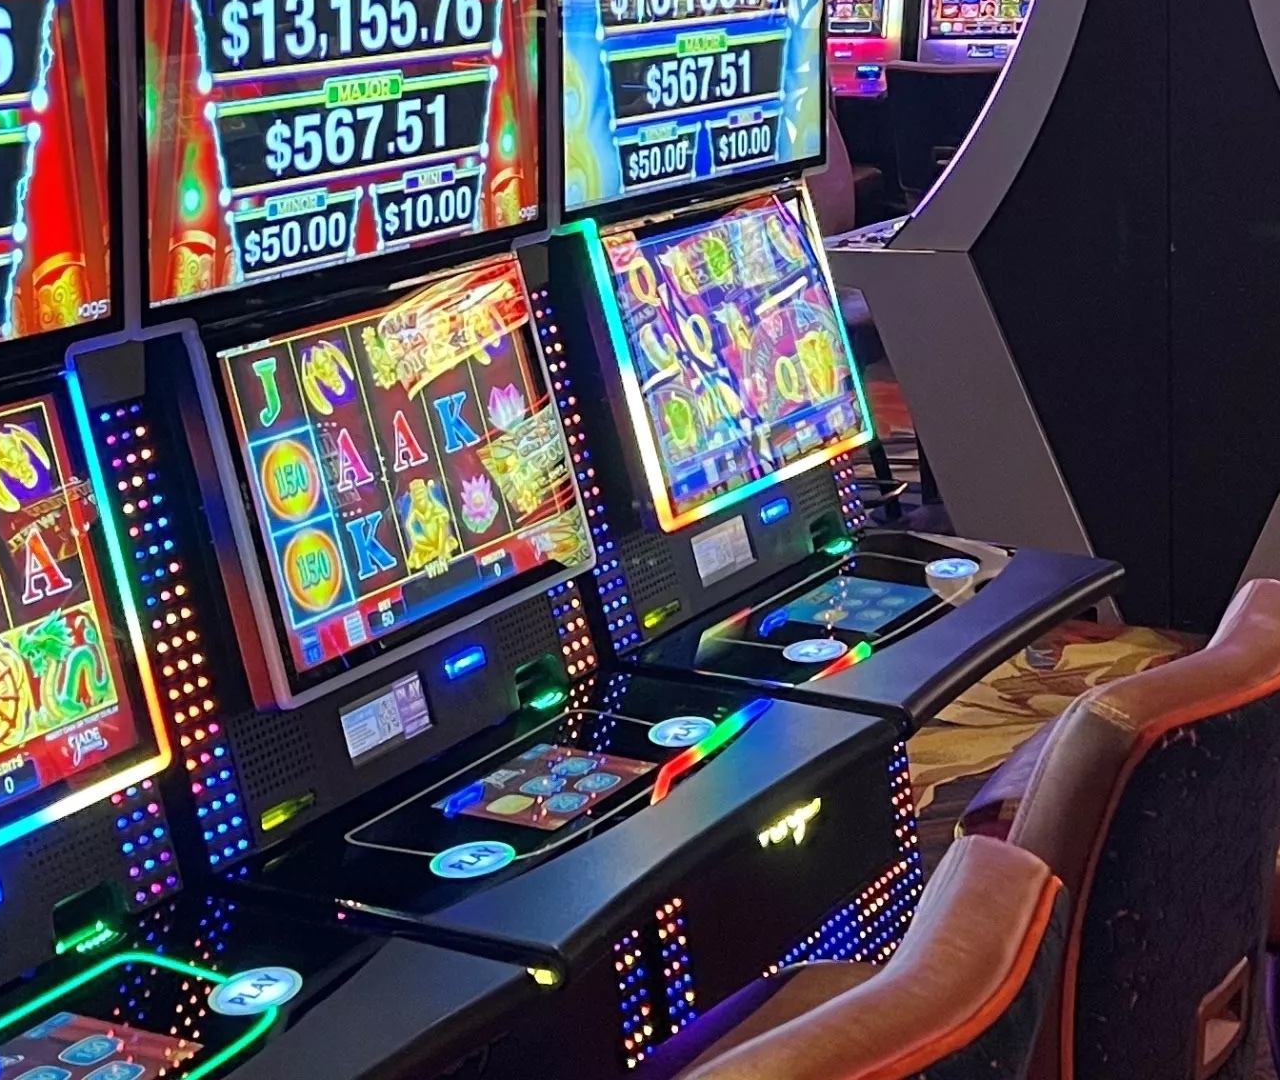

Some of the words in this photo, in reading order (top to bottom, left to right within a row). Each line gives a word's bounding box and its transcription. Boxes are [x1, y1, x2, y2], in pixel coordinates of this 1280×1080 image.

[336, 78, 395, 102] MAJOR
[646, 49, 751, 110] $567.51
[265, 94, 447, 178] $567.51
[719, 125, 771, 162] $10.00
[629, 140, 687, 180] $50.00
[384, 186, 472, 235] $10.00
[244, 212, 347, 267] $50.00
[252, 357, 282, 427] J
[393, 410, 429, 471] A
[433, 391, 481, 454] K
[273, 462, 310, 499] 150
[337, 428, 374, 493] A
[346, 510, 397, 581] K
[22, 528, 72, 604] A
[295, 550, 331, 590] 150
[425, 556, 449, 580] WIN
[493, 564, 501, 577] 0
[381, 610, 395, 627] 50
[4, 776, 15, 795] 0
[448, 845, 494, 872] PLAY
[226, 973, 281, 1007] PLAY
